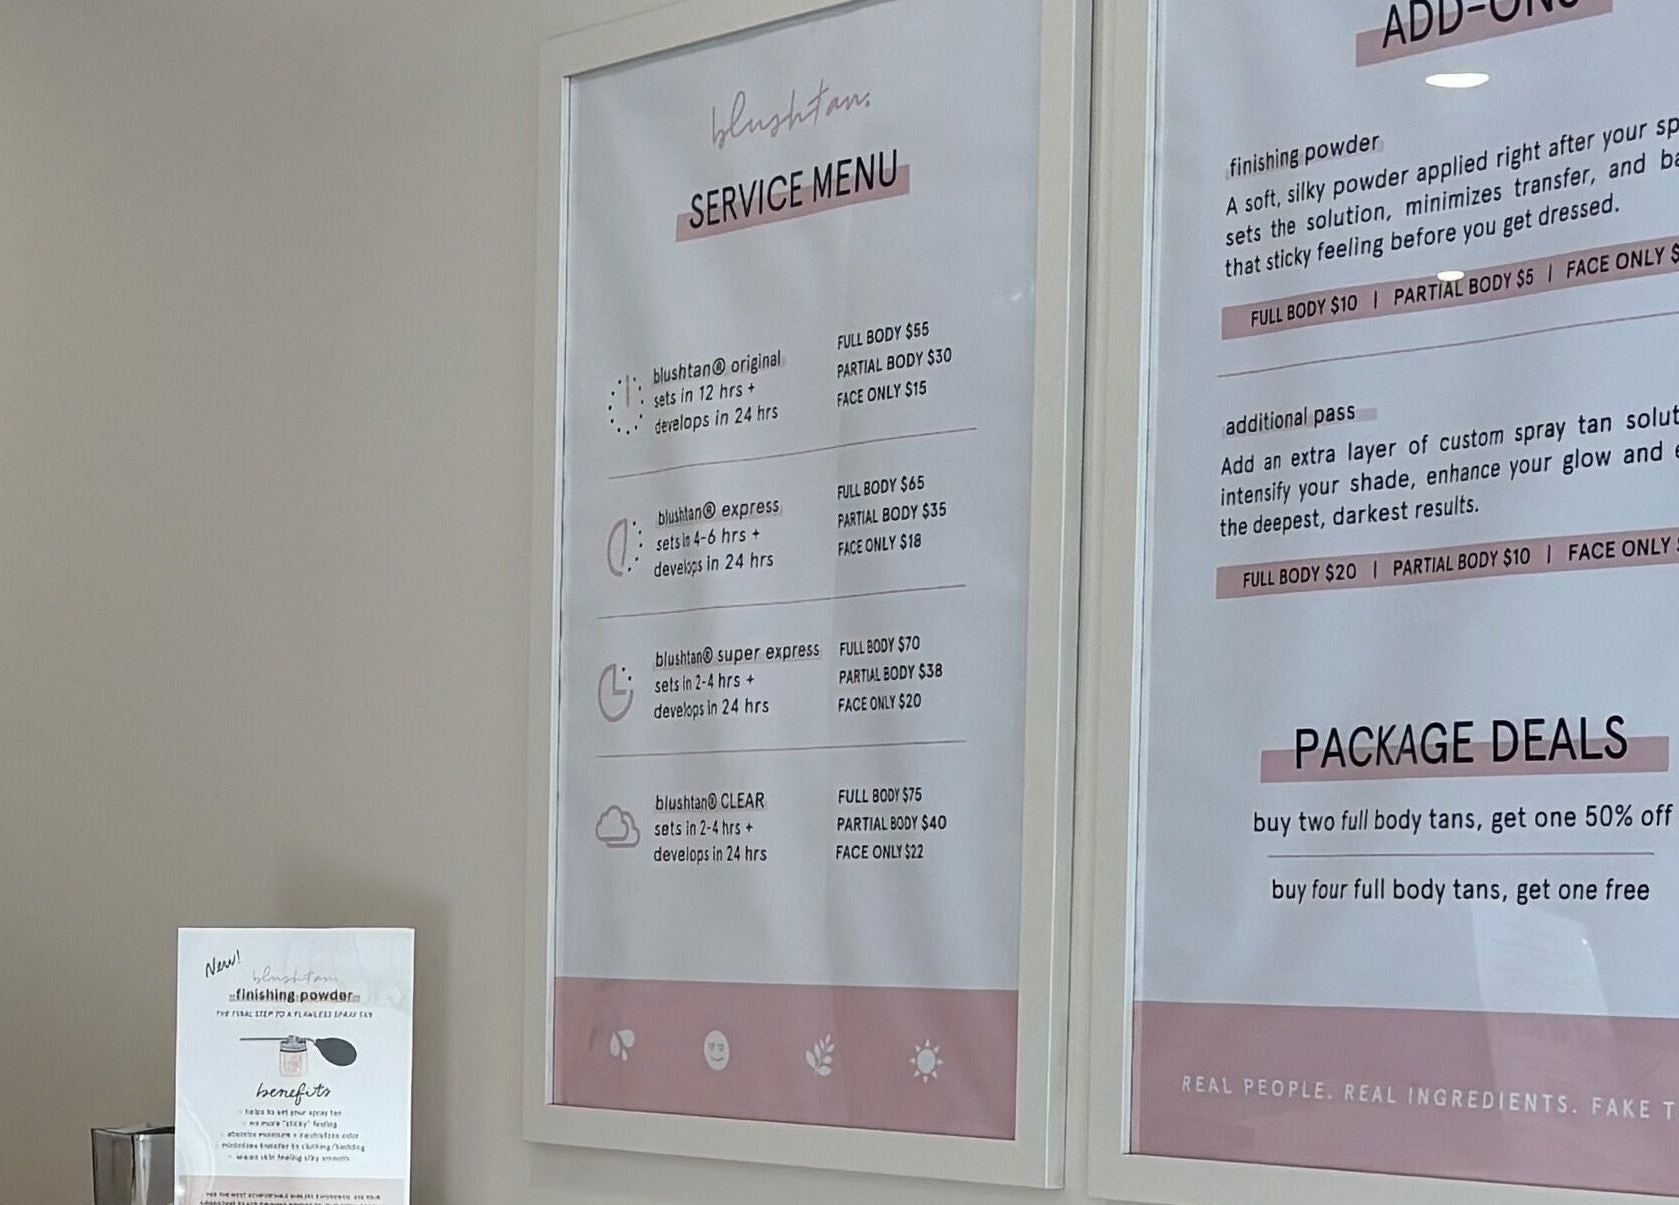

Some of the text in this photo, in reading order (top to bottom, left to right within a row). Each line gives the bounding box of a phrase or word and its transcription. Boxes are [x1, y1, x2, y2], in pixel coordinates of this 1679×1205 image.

[1224, 121, 1648, 217] A soft, silky powder applied right after your
[1229, 133, 1380, 177] finishing powder
[688, 147, 897, 230] SERVICE MENU
[1224, 151, 1646, 247] sets the solution, minimizes transfer, and
[1224, 192, 1620, 278] that sticky feeling before you get dressed.
[1250, 245, 1666, 328] FULL BODY $10 PARTIAL BODY $5 FACE ONLY
[836, 319, 930, 350] FULL BODY $55
[729, 348, 781, 375] original
[836, 346, 952, 379] PARTIAL BODY $30
[653, 389, 677, 409] sets
[679, 386, 693, 403] in
[698, 382, 714, 401] 12
[718, 382, 743, 399] hrs
[836, 378, 927, 408] FACE ONLY $15
[653, 404, 779, 435] develops in 24 hrs
[1224, 404, 1356, 436] additional pass
[1219, 413, 1612, 476] Add an extra layer of custom spray tan
[836, 473, 925, 500] FULL BODY $65
[1220, 439, 1663, 506] intensify your shade, enhance your glow and
[720, 499, 780, 520] express
[836, 500, 947, 529] PARTIAL BODY $35
[1219, 494, 1479, 537] the deepest, darkest results.
[837, 531, 922, 557] FACE ONLY $18
[716, 646, 761, 666] super
[764, 642, 820, 662] express
[1295, 714, 1628, 769] PACKAGE DEALS
[719, 790, 765, 810] CLEAR
[837, 785, 923, 804] FULL BODY $75
[836, 813, 947, 832] PARTIAL BODY $40
[1252, 802, 1674, 837] buy two full body tans, get one 50% off
[834, 842, 924, 860] FACE ONLY $22
[1271, 876, 1650, 906] buy four full body tans, get one free
[204, 948, 241, 978] New!
[235, 987, 353, 1004] finishing powder
[255, 1081, 331, 1107] benefits
[1180, 1074, 1650, 1119] REAL PEOPLE. REAL INGREDIENTS. FAKE
